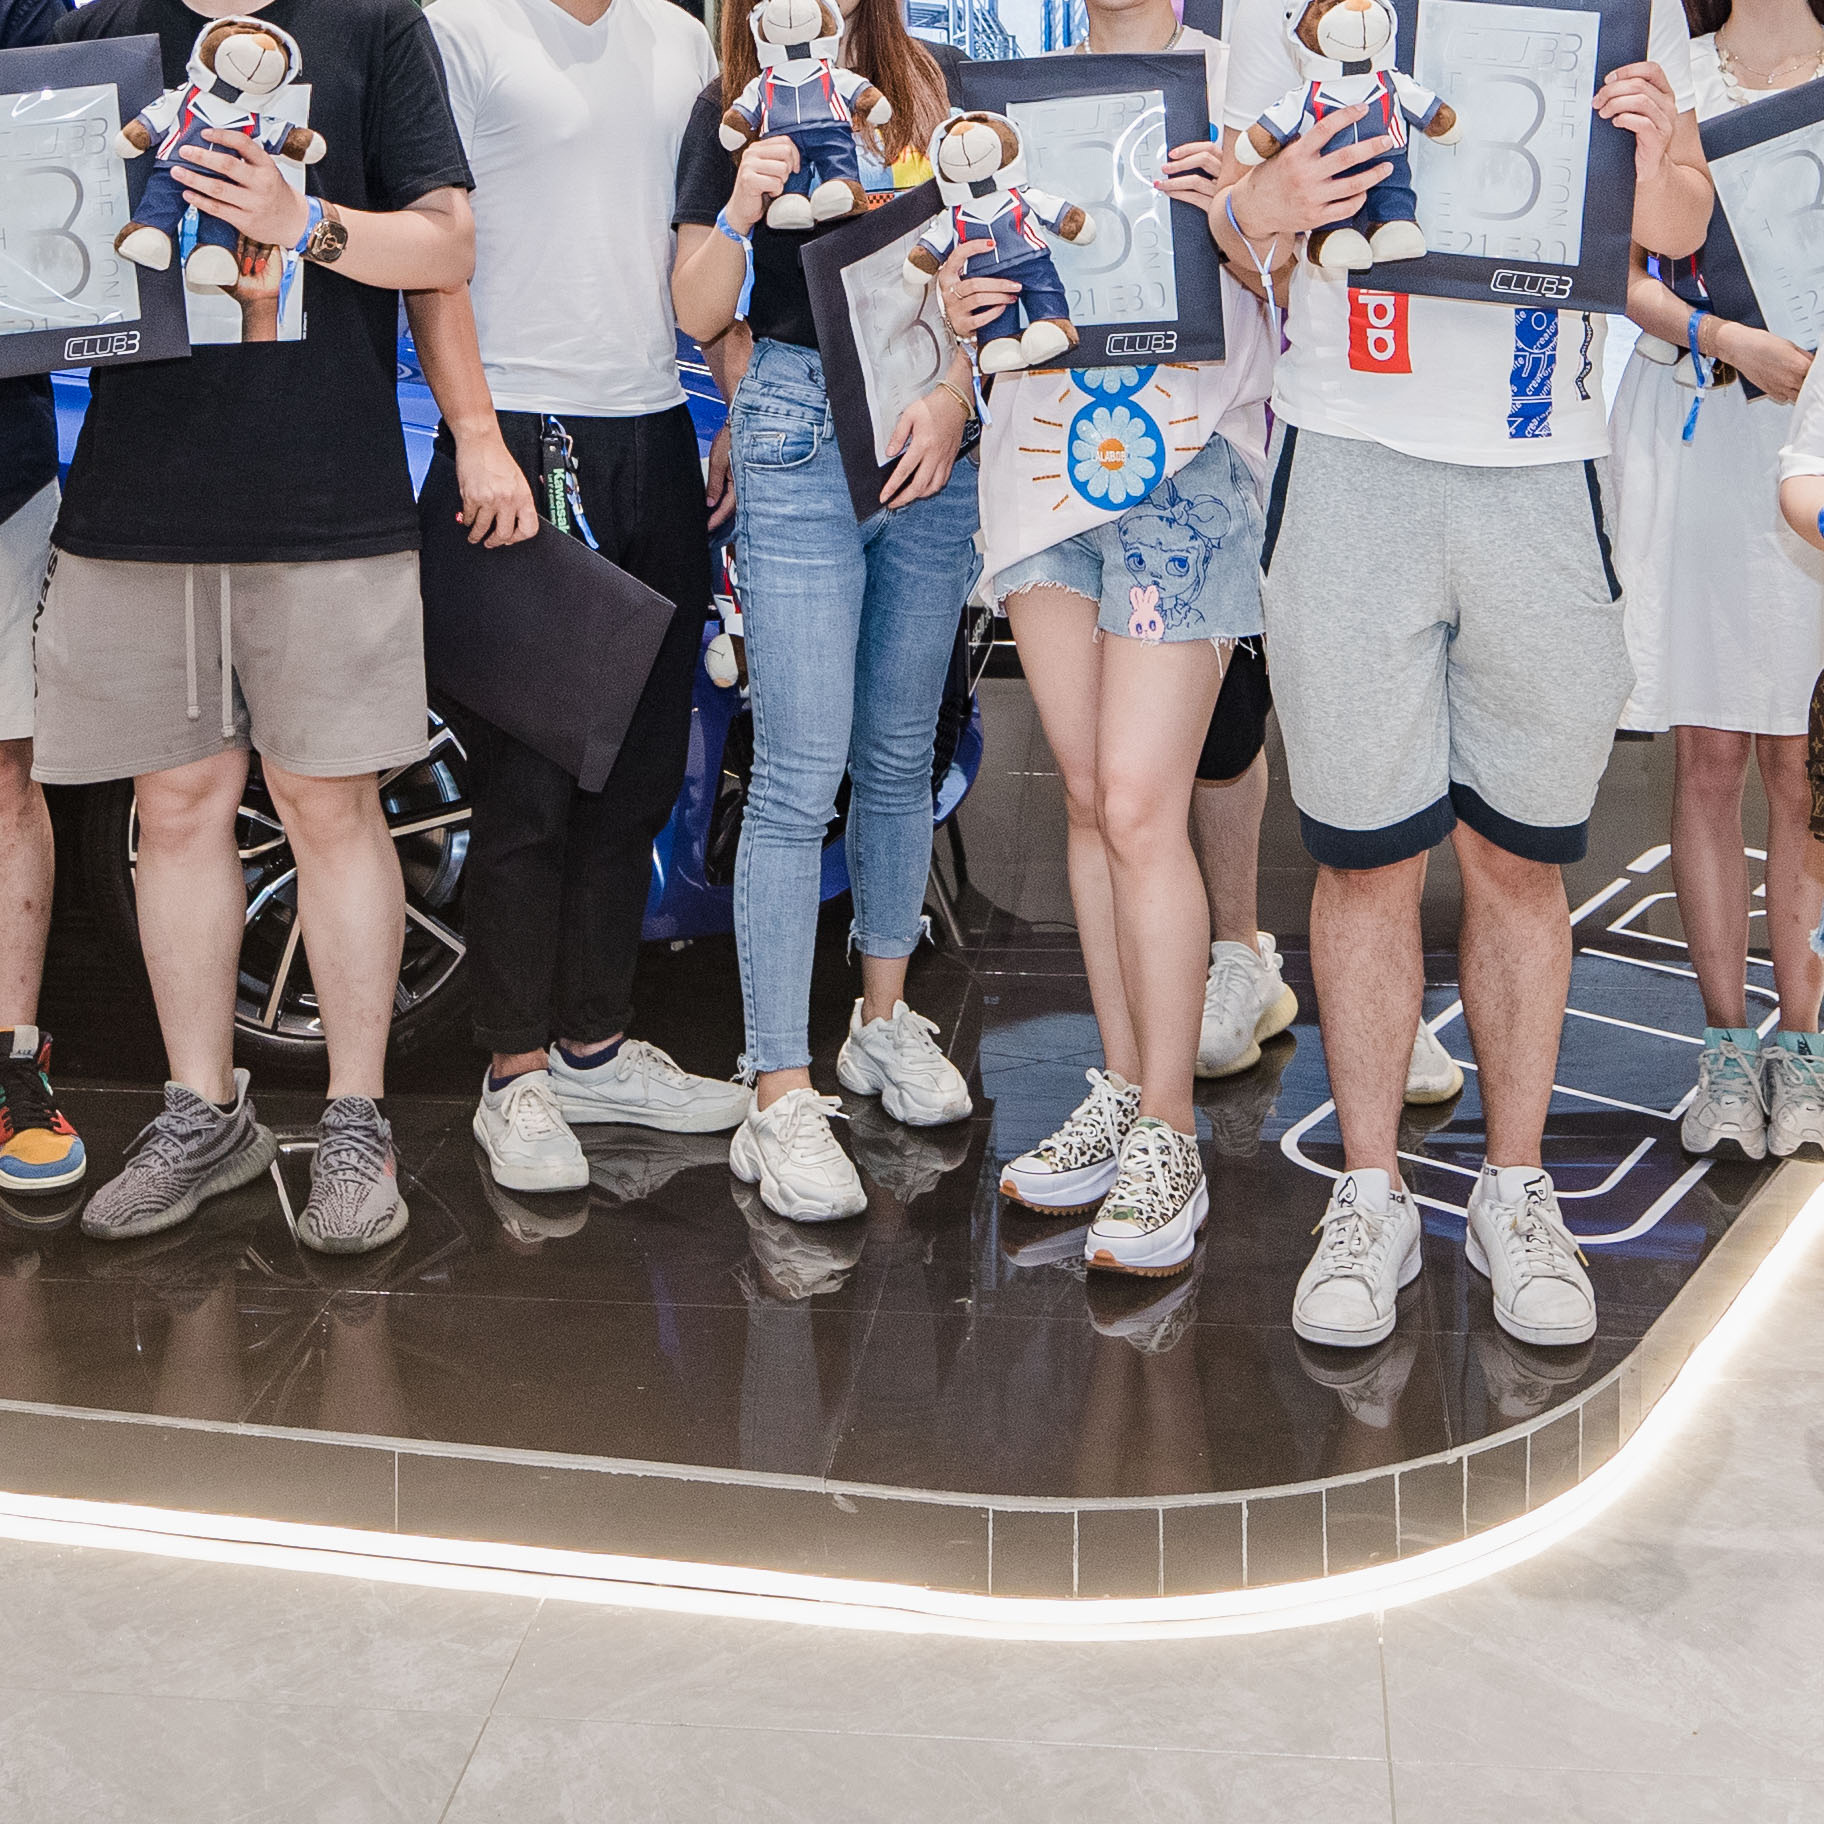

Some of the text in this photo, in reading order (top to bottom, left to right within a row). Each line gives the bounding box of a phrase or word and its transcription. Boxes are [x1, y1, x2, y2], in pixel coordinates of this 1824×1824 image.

[1490, 268, 1573, 299] CLUB3
[64, 331, 141, 361] CLUB3
[1106, 331, 1178, 356] CLUB3
[552, 468, 570, 535] Kawasak
